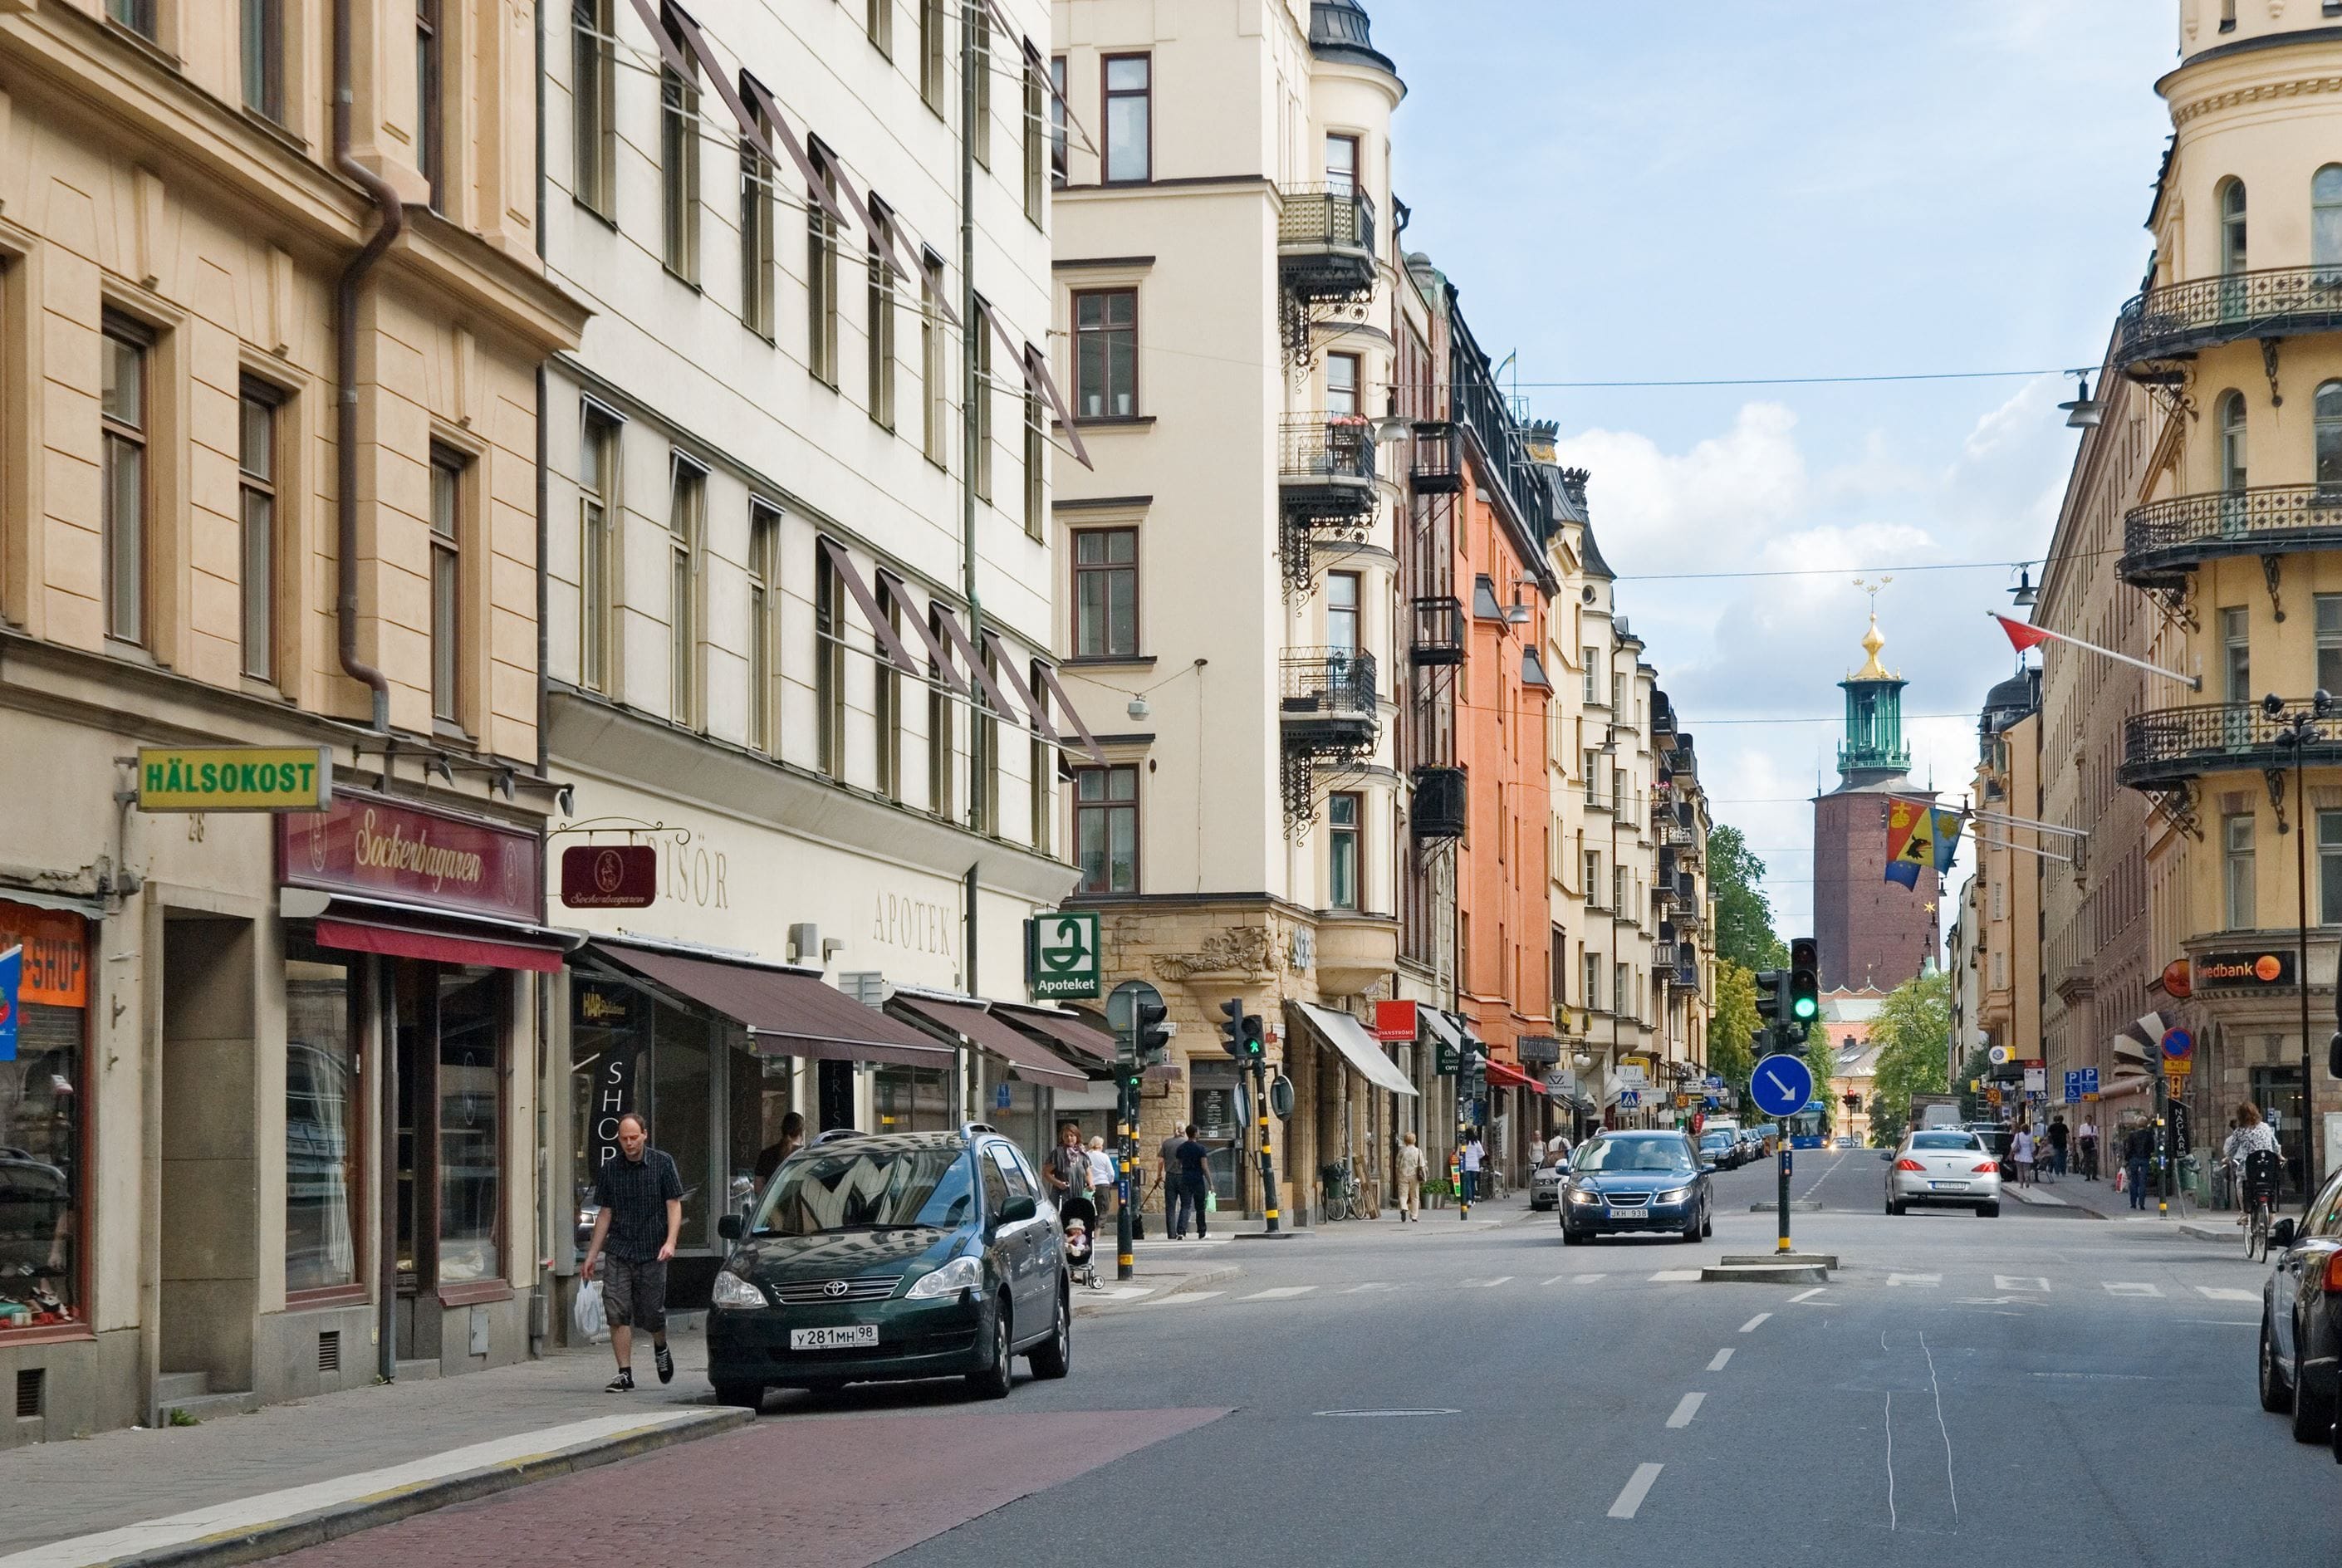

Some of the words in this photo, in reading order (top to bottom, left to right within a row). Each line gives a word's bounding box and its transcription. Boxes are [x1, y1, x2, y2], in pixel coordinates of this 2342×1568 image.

[146, 757, 315, 793] HÄLSOKOST
[355, 808, 482, 893] Sockerbagaren
[633, 831, 728, 909] ISÖR
[571, 892, 645, 904] Sockerbagaren
[873, 887, 951, 956] APOTEK
[1038, 978, 1095, 993] Apoteket
[2069, 1072, 2077, 1083] P
[2085, 1069, 2095, 1080] P
[1677, 1096, 1687, 1105] 30
[598, 1061, 623, 1169] SHOP
[2175, 1108, 2186, 1149] NAGLAR
[859, 1327, 872, 1337] 98
